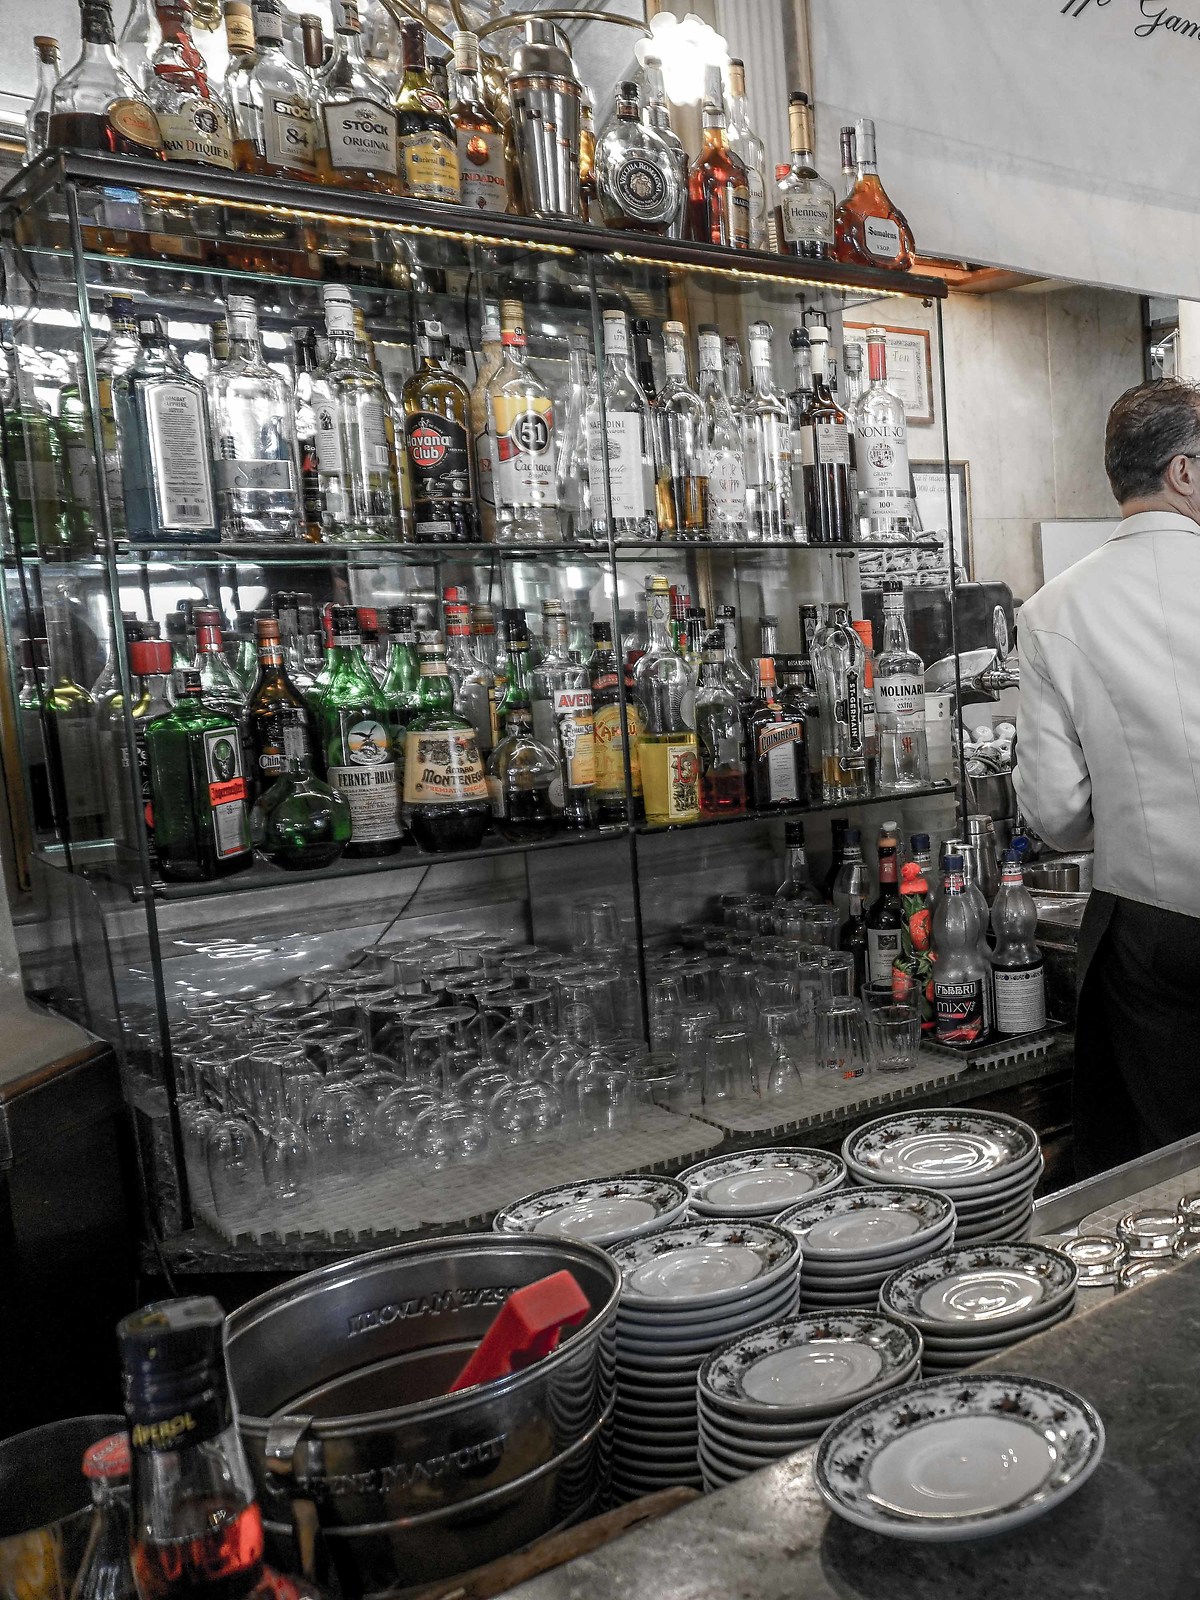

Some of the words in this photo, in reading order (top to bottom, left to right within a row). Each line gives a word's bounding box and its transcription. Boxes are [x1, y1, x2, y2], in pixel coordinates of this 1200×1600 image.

[342, 119, 389, 136] STOCK
[286, 128, 309, 147] 84
[342, 135, 391, 152] ORIGINAL
[185, 139, 222, 157] DUQUE
[791, 206, 829, 220] Hennessy
[406, 435, 450, 447] Havana
[520, 422, 546, 444] 51
[412, 446, 440, 460] Club
[880, 684, 924, 697] MOLINARI
[849, 683, 858, 738] ST-GERMAIN
[761, 725, 799, 751] COINTREAU
[445, 765, 474, 775] AMARO
[937, 984, 974, 995] FABBRI
[936, 1000, 972, 1018] mixy
[132, 1411, 198, 1448] APEROL
